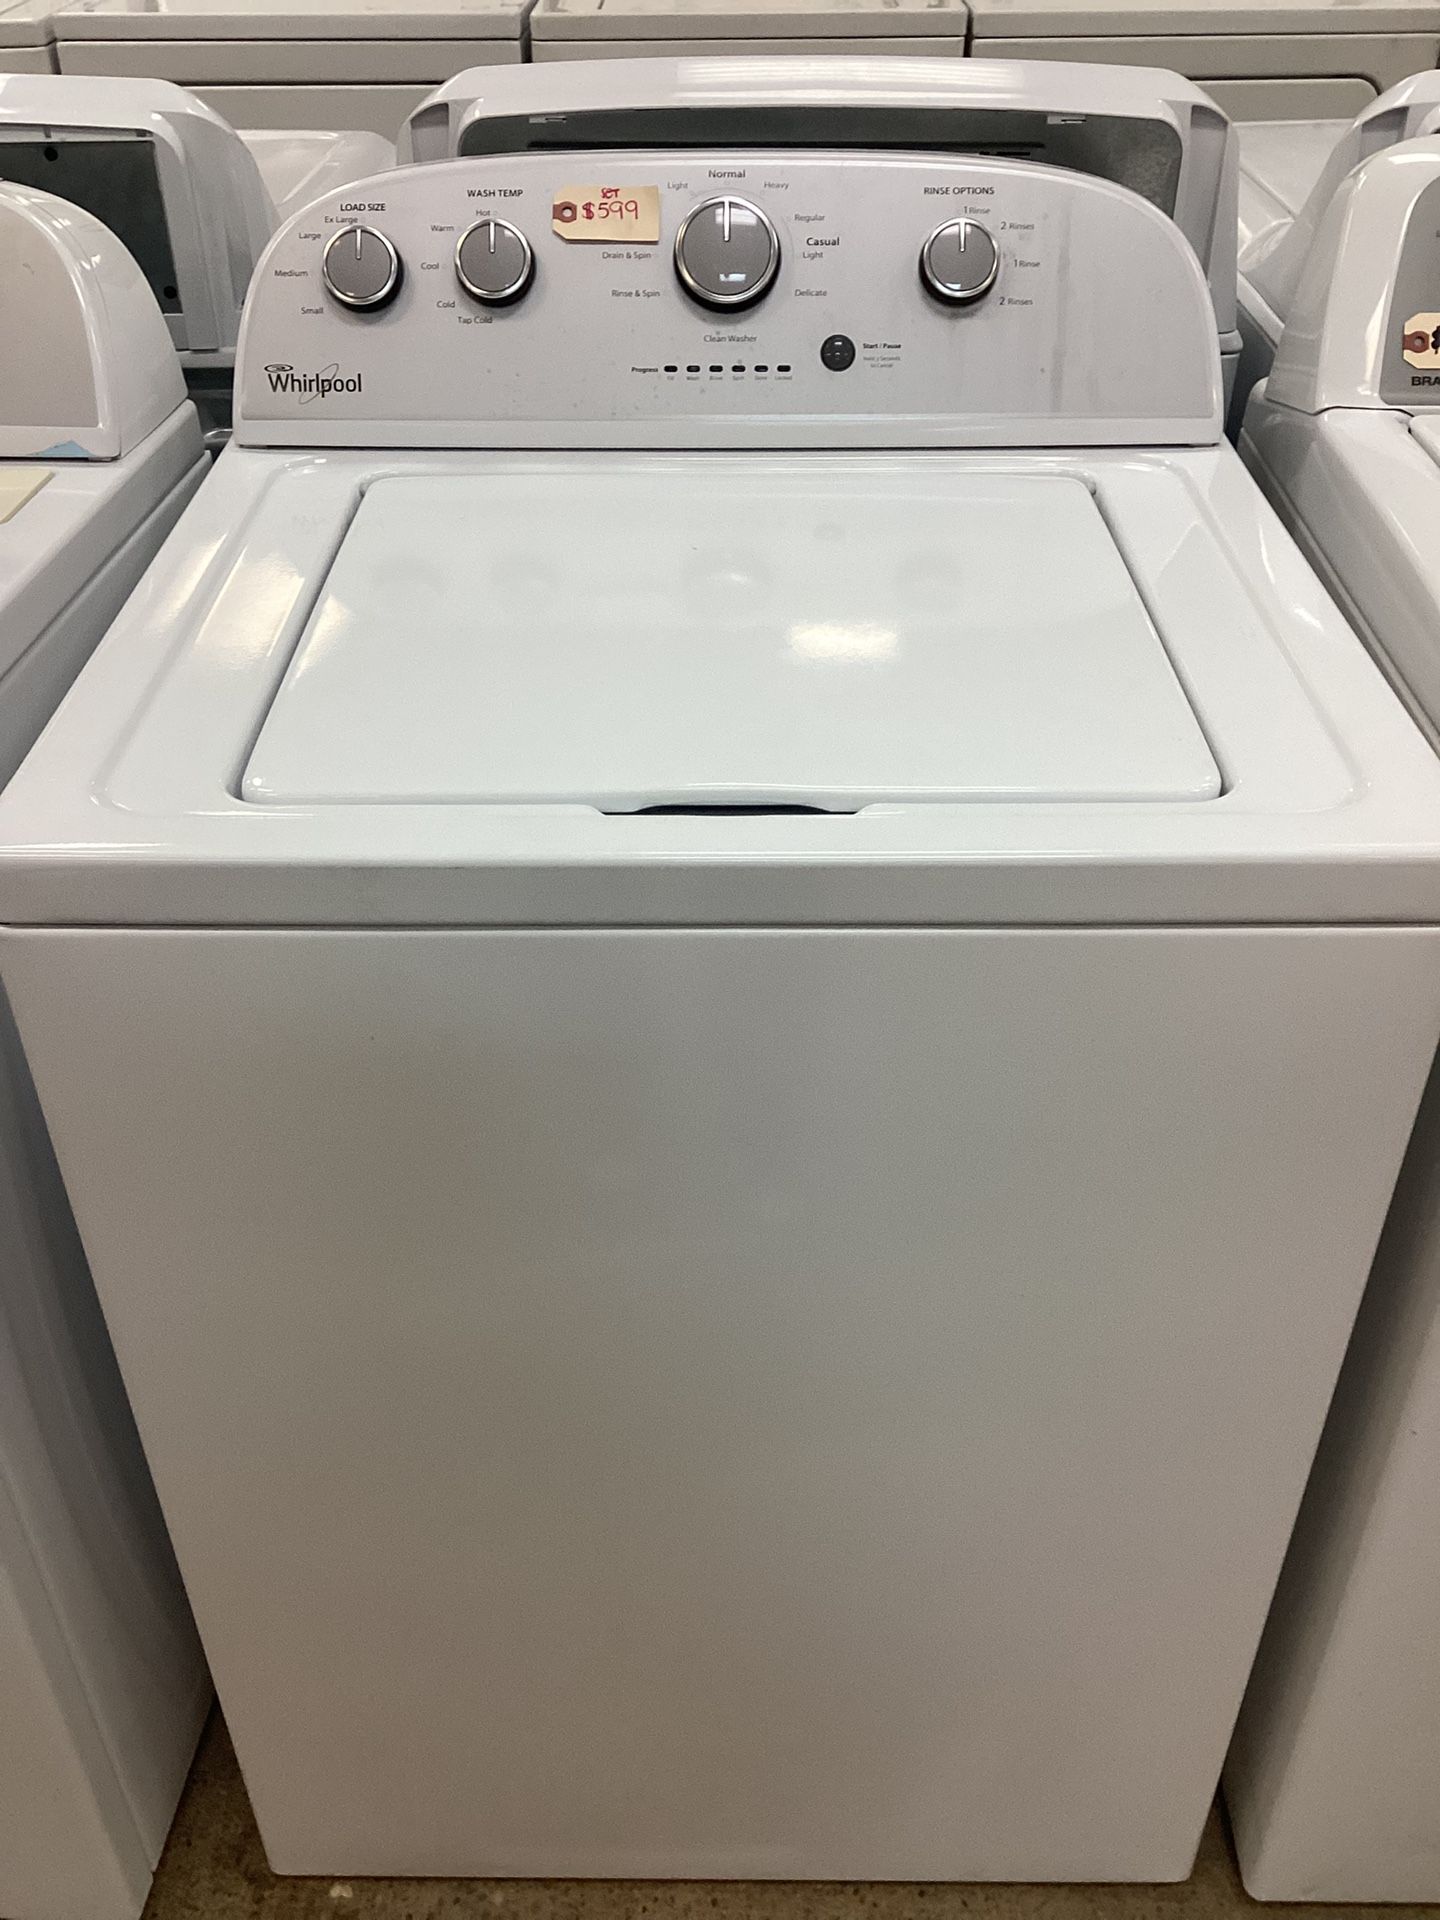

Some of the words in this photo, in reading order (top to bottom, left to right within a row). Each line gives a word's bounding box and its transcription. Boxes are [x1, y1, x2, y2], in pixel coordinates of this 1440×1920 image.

[708, 170, 747, 179] Normal
[668, 182, 689, 191] Light
[764, 182, 790, 191] Heavy
[467, 190, 496, 198] WASH
[498, 190, 524, 198] TEMP
[601, 188, 620, 199] SET
[924, 187, 951, 196] RINSE
[953, 187, 995, 196] OPTIONS
[340, 204, 367, 212] LOAD
[368, 204, 387, 212] SIZE
[582, 200, 638, 219] $599
[963, 206, 968, 214] 1
[969, 207, 991, 215] Rinse
[336, 216, 359, 225] Large
[794, 214, 825, 223] Regular
[1000, 222, 1007, 231] 2
[1009, 223, 1035, 231] Rinses
[299, 233, 322, 241] Large
[806, 238, 840, 247] Casual
[602, 252, 625, 260] Drain
[626, 252, 633, 260] &
[634, 251, 652, 262] Spin
[803, 251, 824, 260] Light
[421, 263, 440, 271] Cool
[1013, 259, 1019, 268] 1
[1019, 260, 1041, 269] Rinse
[275, 270, 309, 278] Medium
[612, 290, 633, 298] Rinse
[635, 290, 642, 298] &
[643, 290, 661, 299] Spin
[795, 289, 828, 298] Delicate
[437, 301, 456, 309] Cold
[999, 297, 1006, 306] 2
[1008, 298, 1034, 307] Rinses
[458, 317, 473, 325] Tap
[474, 316, 493, 324] Cold
[704, 335, 726, 344] Clean
[728, 335, 758, 344] Washer
[268, 373, 361, 398] Whirlpool
[1411, 376, 1440, 386] BRA
